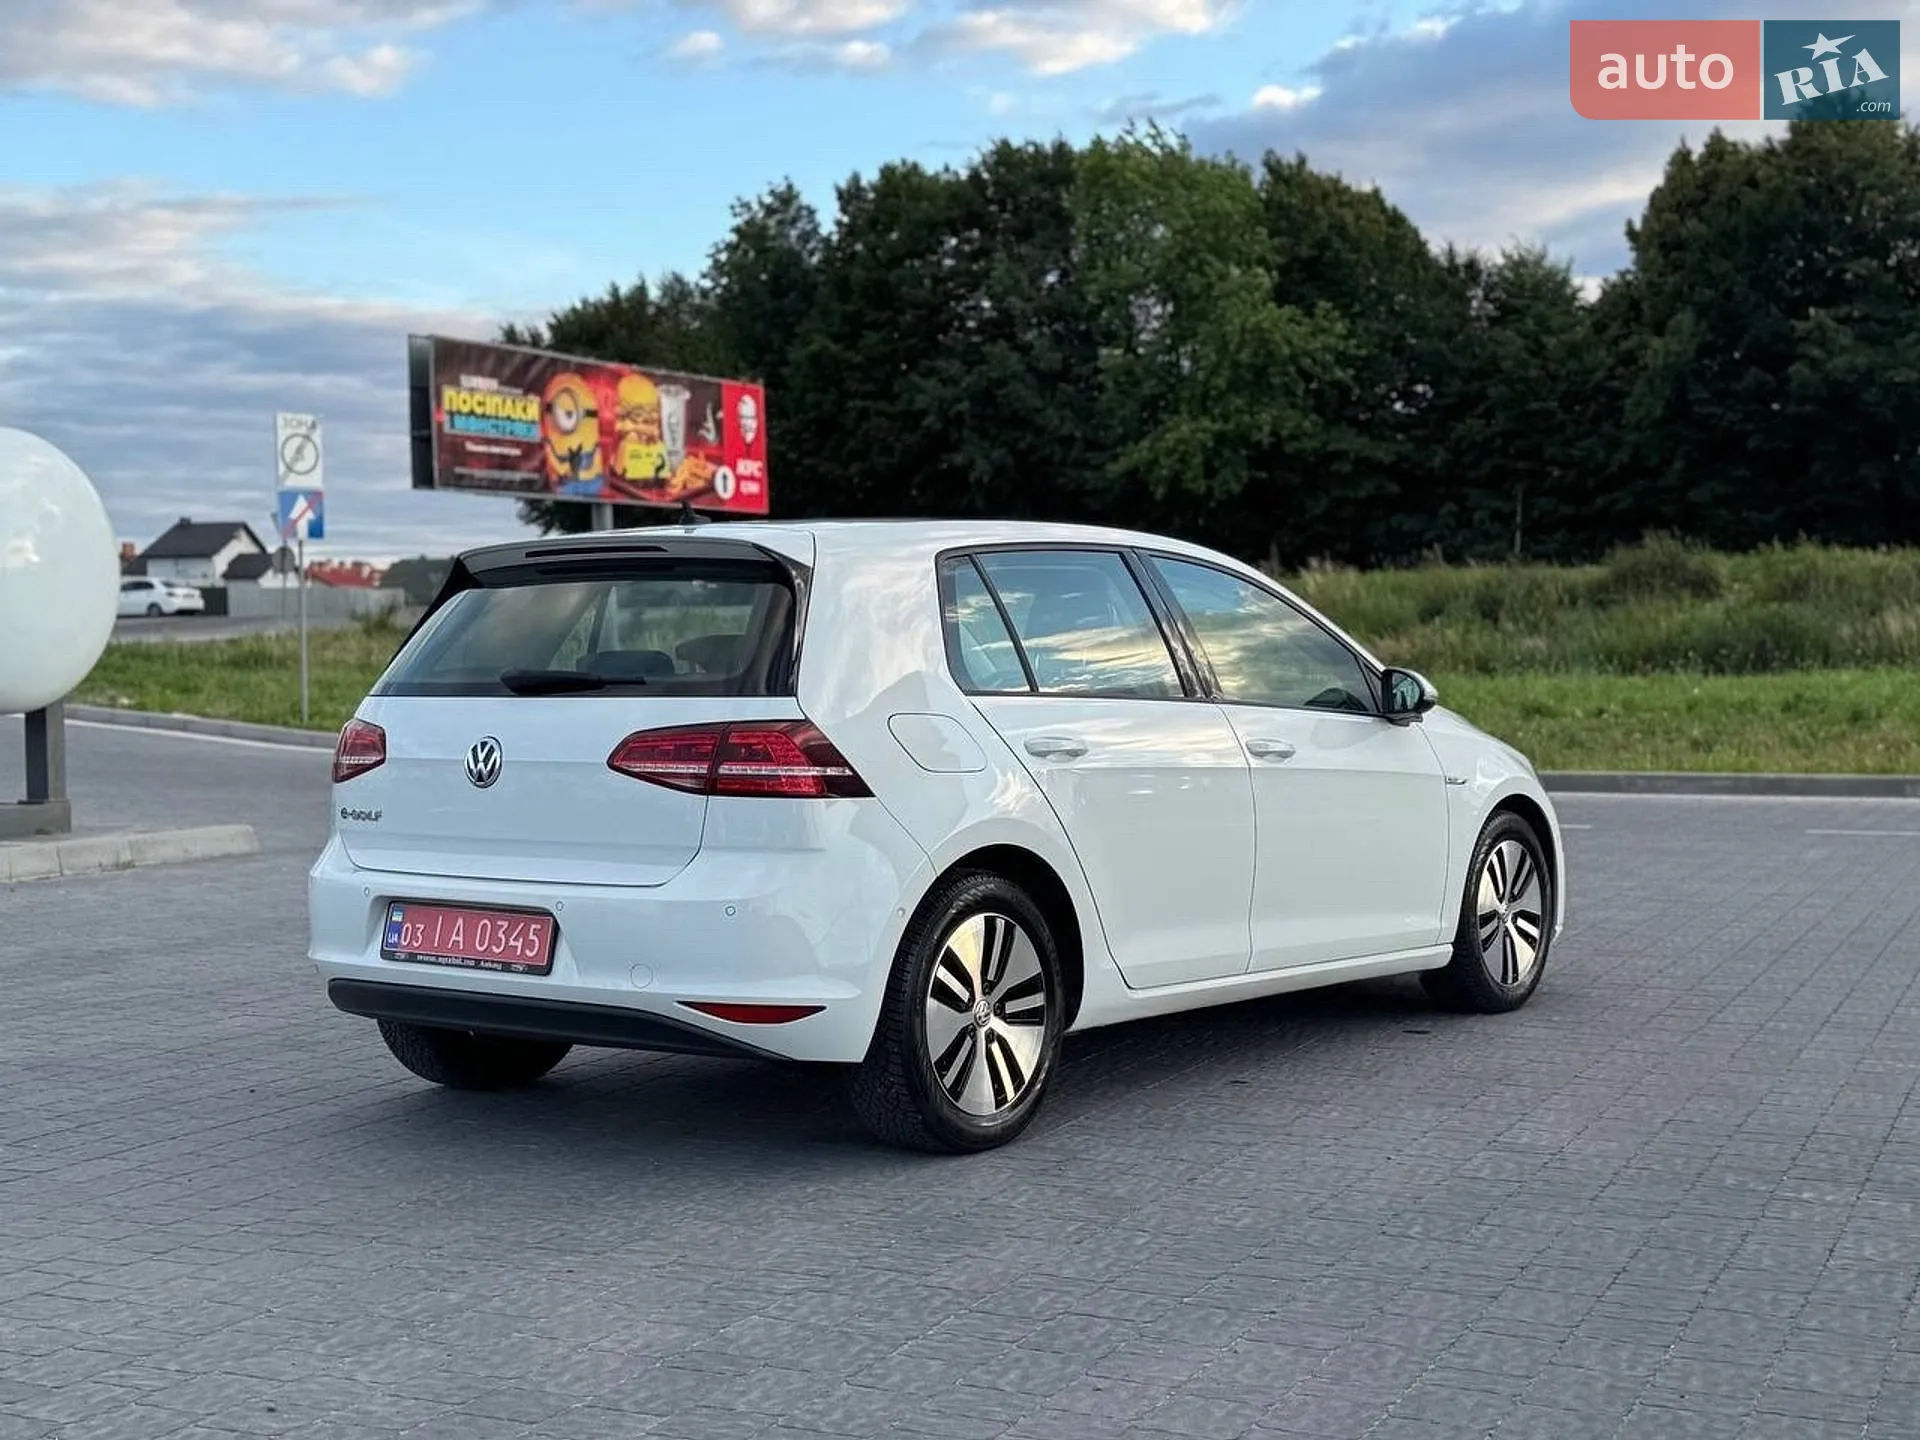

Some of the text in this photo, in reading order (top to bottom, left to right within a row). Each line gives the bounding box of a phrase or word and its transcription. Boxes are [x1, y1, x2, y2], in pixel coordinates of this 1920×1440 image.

[401, 914, 541, 958] 03 IA 0345
